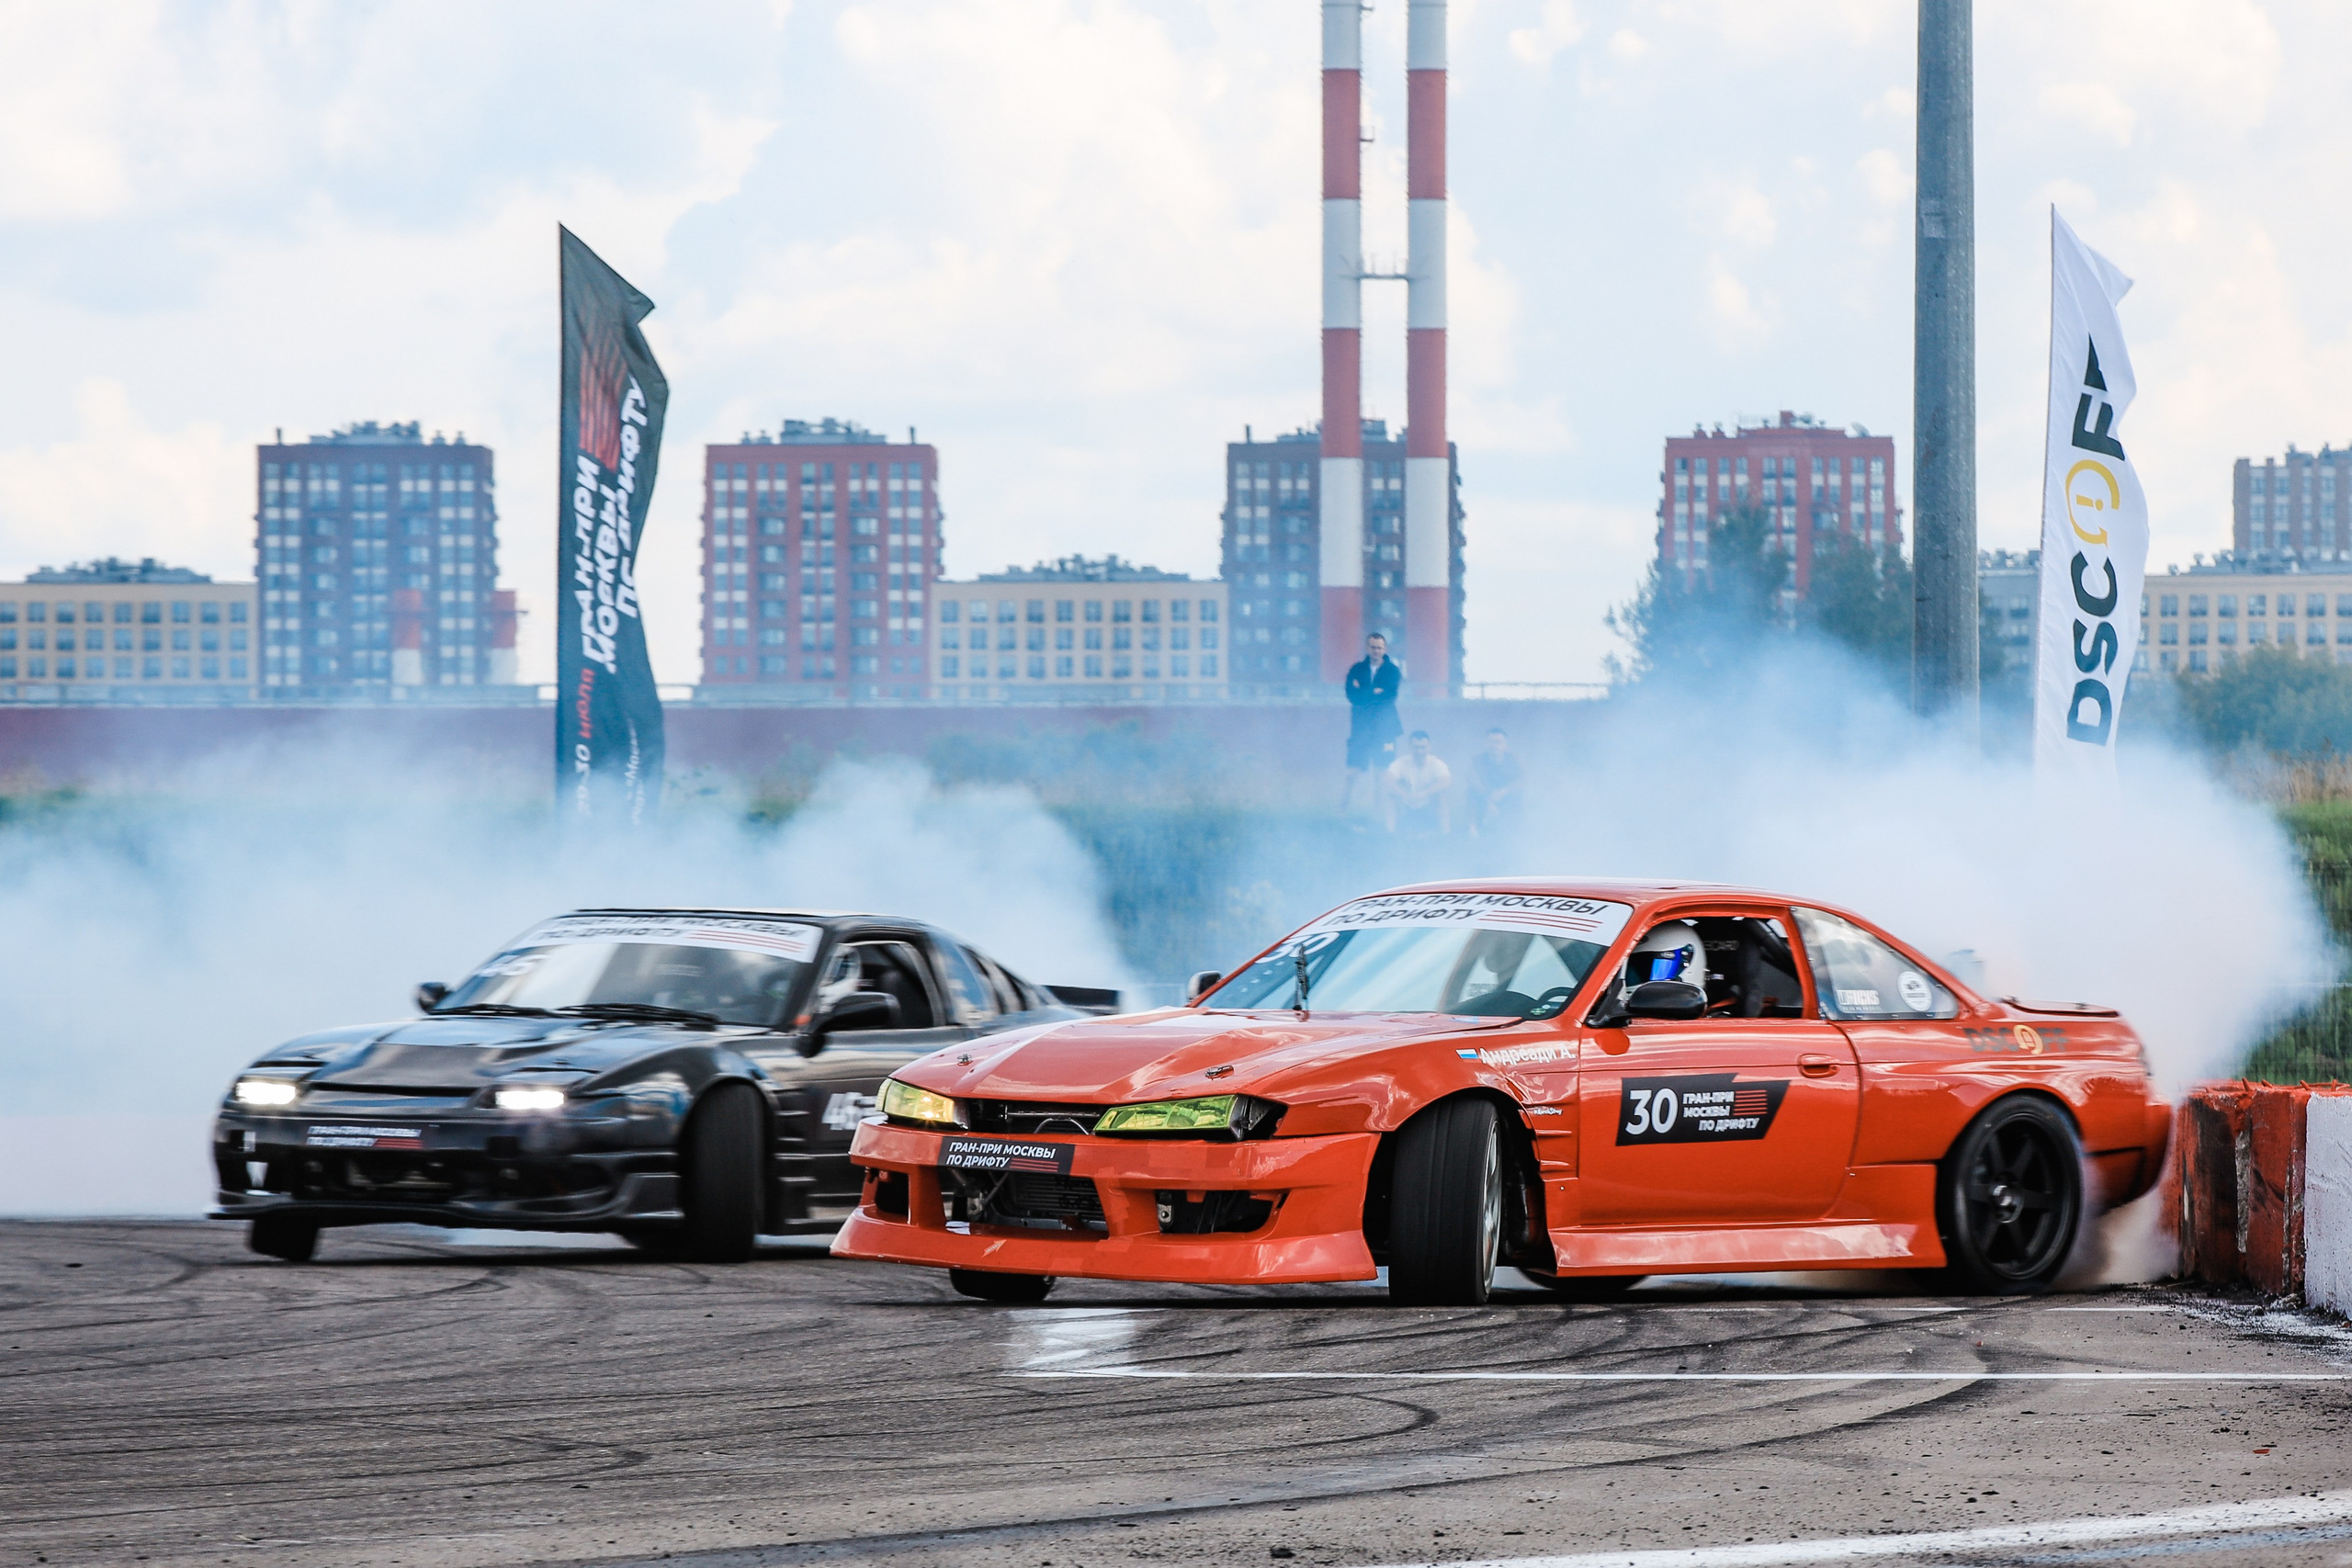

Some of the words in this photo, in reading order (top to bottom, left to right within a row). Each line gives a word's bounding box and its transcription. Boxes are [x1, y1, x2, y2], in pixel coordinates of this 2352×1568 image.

[573, 455, 607, 663] ГРАН-ПРИ
[1340, 894, 1478, 912] ГРАН-ПРИ
[1476, 895, 1610, 915] МОСКВЫ
[1322, 913, 1363, 926] ПО
[1361, 908, 1487, 923] ДРИФТУ
[1255, 931, 1340, 964] 30
[1479, 1047, 1557, 1066] Андреади
[1682, 1091, 1735, 1104] ГРАН-ПРИ
[1624, 1088, 1679, 1135] 30
[1683, 1105, 1730, 1117] МОСКВЫ
[1698, 1120, 1715, 1131] ПО
[1714, 1118, 1759, 1132] ДРИФТУ
[949, 1142, 1002, 1155] ГРАН-ПРИ
[1002, 1144, 1057, 1158] МОСКВЫ
[945, 1154, 963, 1166] ПО
[962, 1155, 1011, 1168] ДРИФТУ
